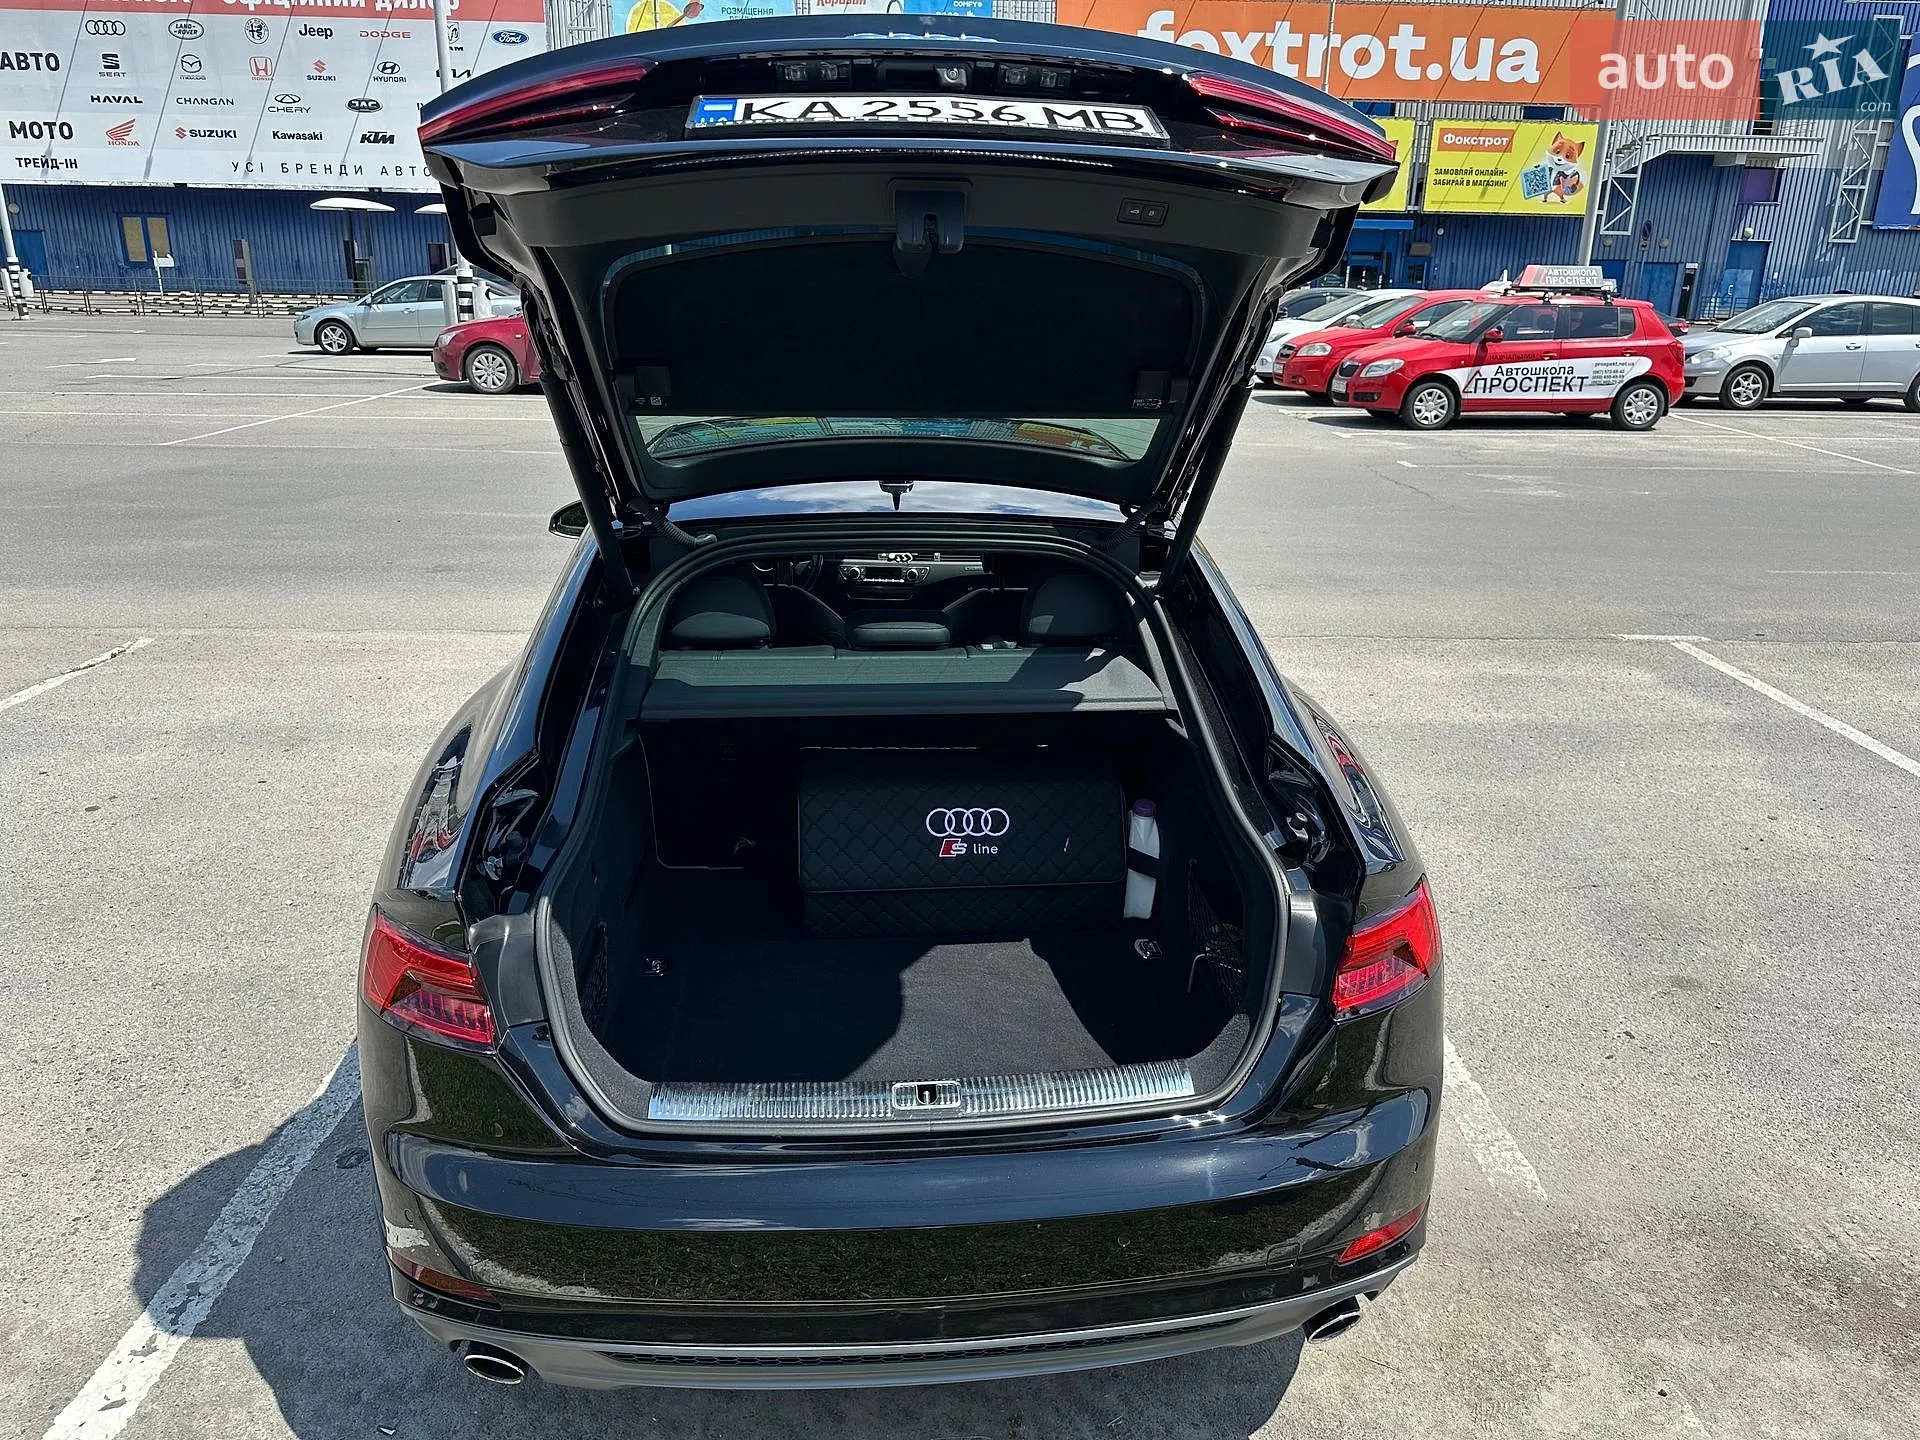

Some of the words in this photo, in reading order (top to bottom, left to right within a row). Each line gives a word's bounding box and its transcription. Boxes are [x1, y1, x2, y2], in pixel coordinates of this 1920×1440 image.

[298, 23, 334, 40] Jeep
[359, 30, 411, 39] DODGE
[498, 31, 522, 43] Ford
[0, 52, 61, 72] АВТО
[306, 74, 337, 82] SUZUKI
[90, 95, 143, 104] HAVAL
[176, 97, 235, 106] CHANGAN
[349, 100, 379, 110] JAC
[267, 105, 312, 114] CHERY
[862, 101, 1026, 122] 2556
[8, 120, 74, 141] МОТО
[189, 128, 237, 139] SUZUKI
[271, 130, 324, 141] Kawasaki
[107, 139, 141, 147] HONDA
[360, 131, 395, 145] KTM
[1442, 132, 1510, 148] Фокстрот
[15, 154, 78, 170] ТРЕЙД-ІН
[231, 161, 264, 173] УСІ
[281, 162, 363, 177] БРЕНДИ
[1433, 167, 1474, 177] ЗАМОВЛЯЙ
[1432, 177, 1464, 187] ЗАБИРАЙ
[1465, 179, 1471, 187] В
[1547, 268, 1597, 277] АВТОШКОЛА
[1545, 276, 1599, 285] ПРОСПЕКТ
[1494, 365, 1574, 377] Автошкола
[1473, 376, 1589, 394] ПРОСПЕКТ
[973, 843, 999, 855] line
